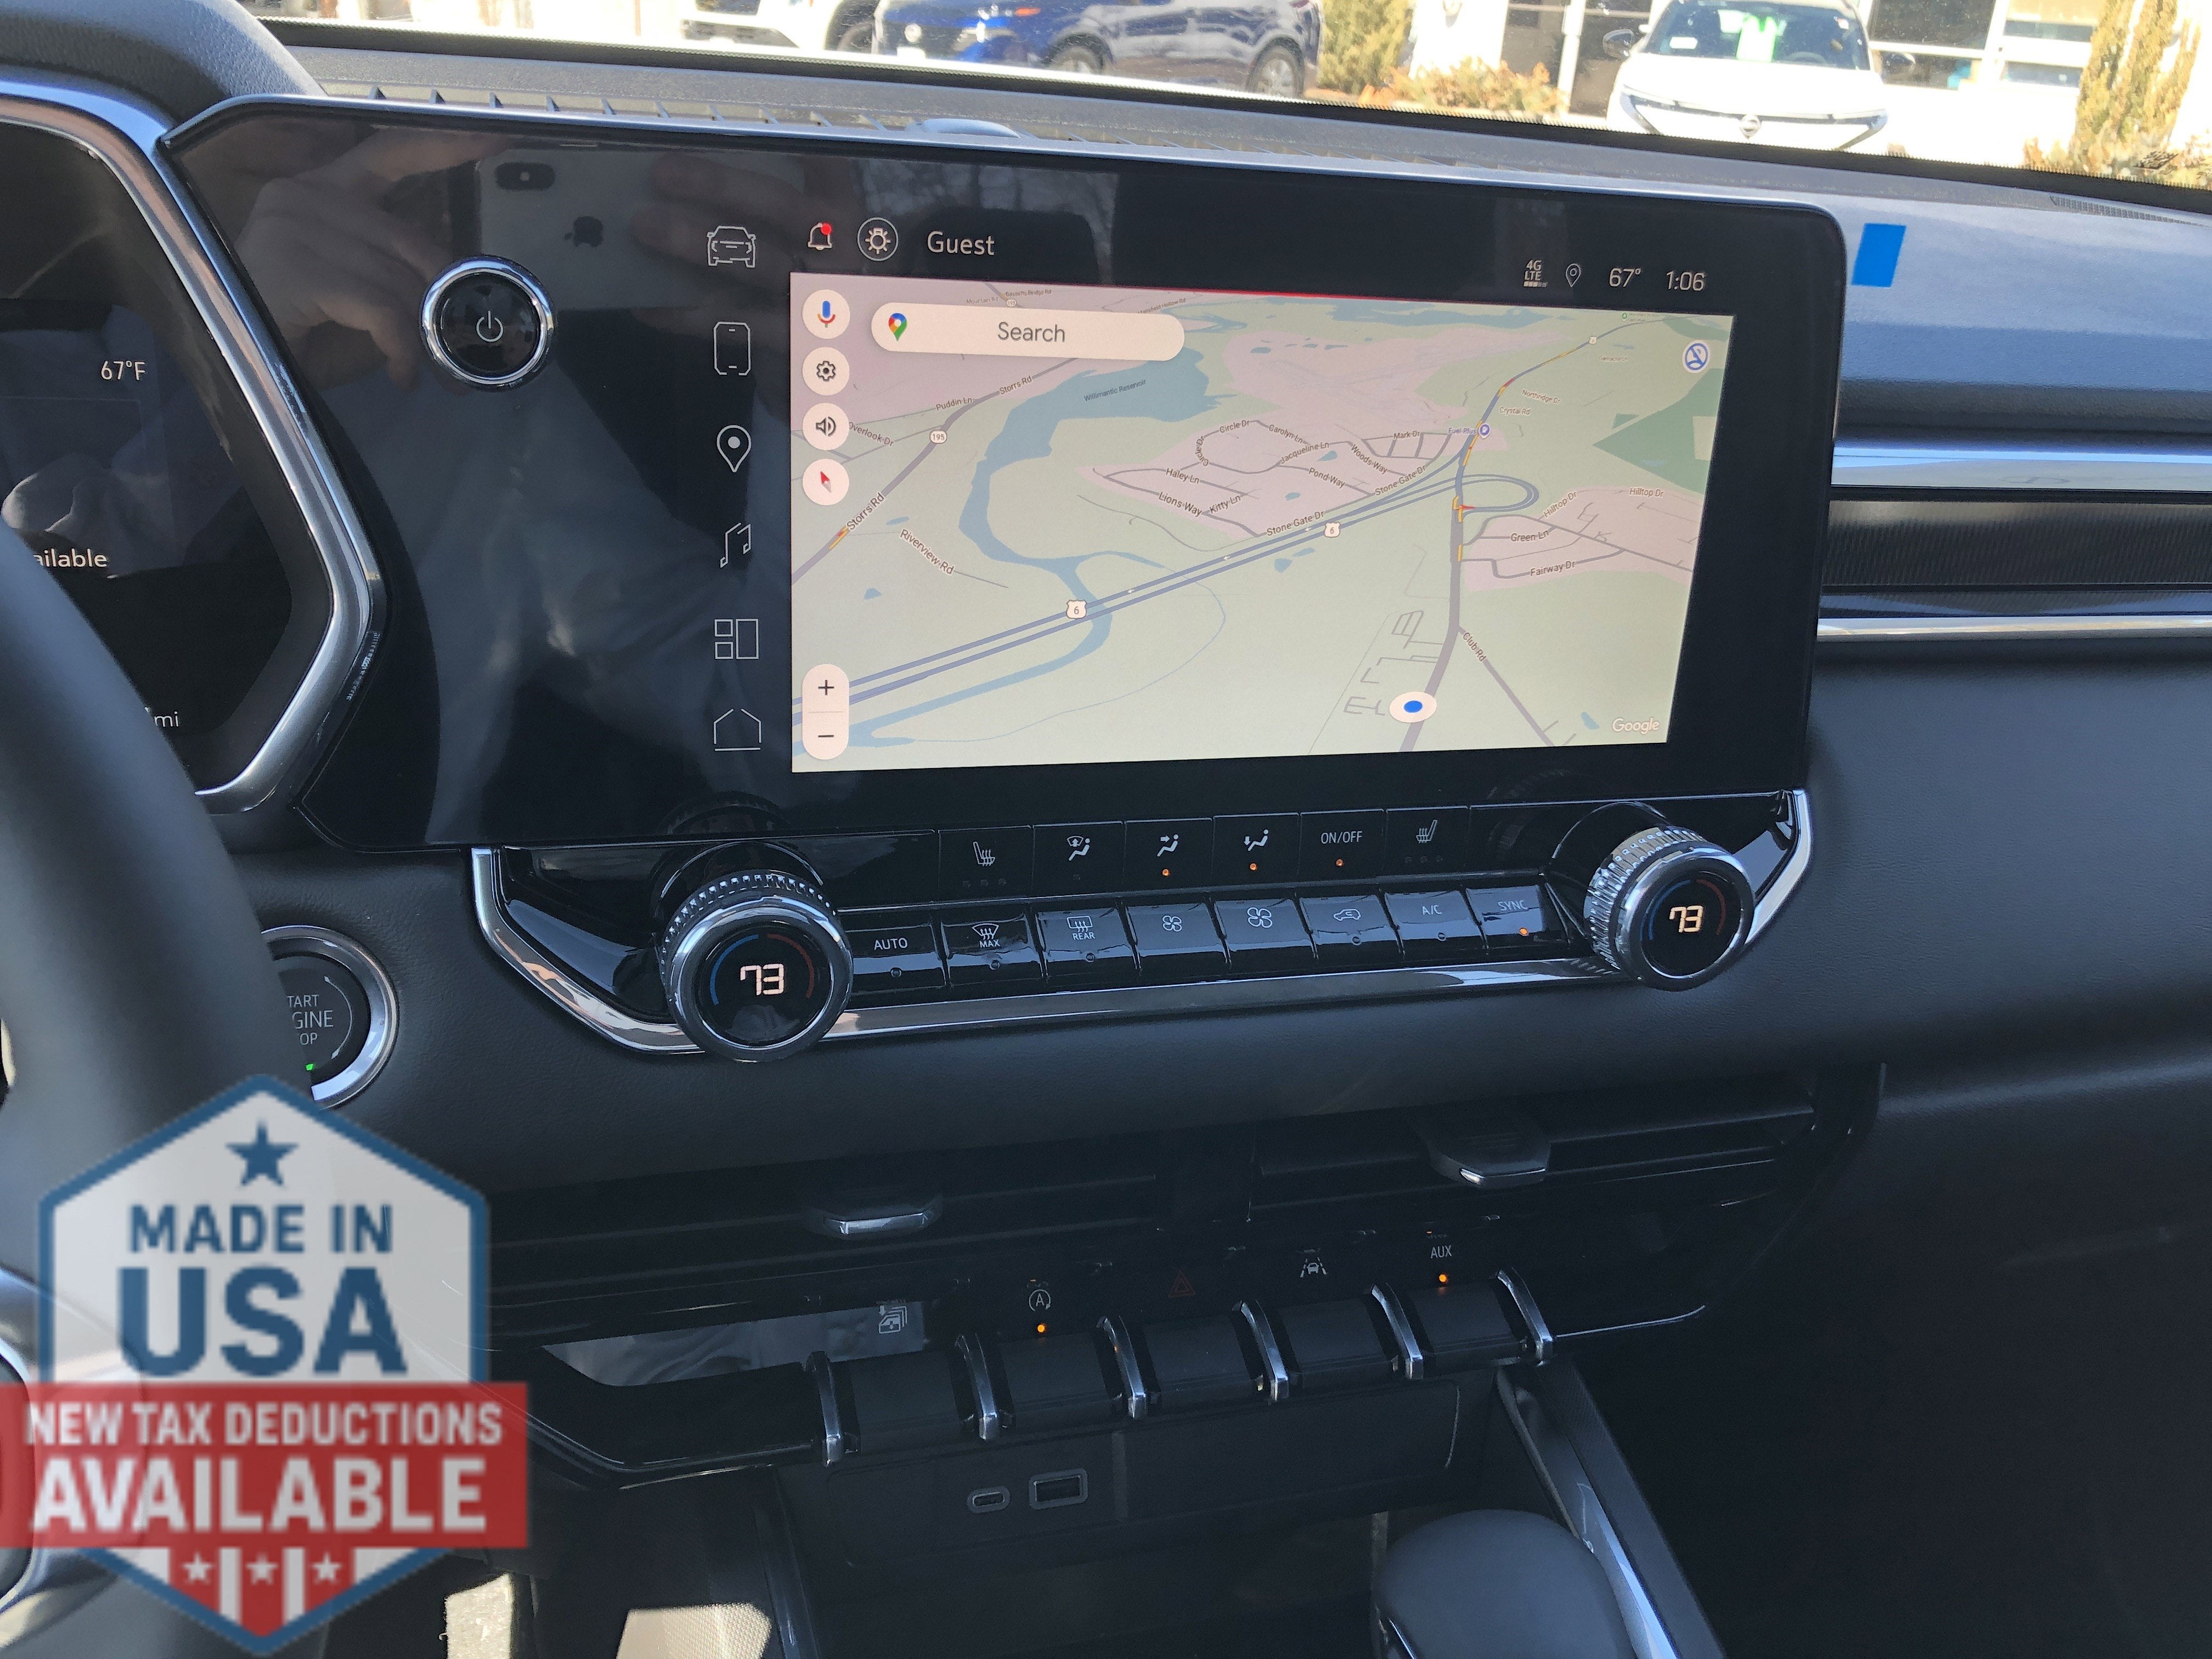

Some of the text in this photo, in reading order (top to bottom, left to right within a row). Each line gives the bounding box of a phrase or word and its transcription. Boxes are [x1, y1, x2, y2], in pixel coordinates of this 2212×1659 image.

[927, 230, 995, 256] Guest
[1525, 259, 1542, 271] 4G
[1524, 271, 1542, 281] LTE
[1609, 267, 1642, 287] 67°
[1666, 270, 1706, 291] 1:06
[997, 321, 1066, 343] Search
[999, 375, 1032, 396] Storrs Rd
[1084, 379, 1147, 402] Willimantic Reservoir
[935, 396, 973, 411] Puddin Ln
[1521, 389, 1551, 403] Northridge
[1499, 407, 1520, 416] Crystal
[849, 421, 894, 447] Overlook Dr
[1219, 422, 1240, 433] Circle
[1268, 424, 1304, 444] Carolyn Ln
[1393, 431, 1411, 439] Mark
[1195, 435, 1209, 466] Circle Dr
[1280, 443, 1319, 464] Jacqueline
[1351, 444, 1388, 475] Woods Way
[1165, 467, 1200, 484] Haley Ln
[1308, 467, 1346, 488] Pond Way
[1375, 466, 1426, 496] Stone Gate Dr
[1629, 487, 1664, 498] Hilltop Dr
[846, 492, 885, 531] Storrs Rd
[1158, 491, 1203, 518] Lions Way
[1209, 495, 1241, 515] Kitty Ln
[1543, 490, 1577, 518] Hilltop Dr
[1266, 510, 1325, 537] Stone Gate Dr
[1510, 529, 1549, 542] Green Ln
[900, 528, 955, 575] Riverview Rd
[1530, 560, 1576, 578] Fairway Dr
[1073, 605, 1080, 616] 6
[1462, 632, 1487, 663] Club Rd
[154, 711, 179, 727] mi
[1611, 717, 1660, 734] Google
[1320, 830, 1363, 844] ON/OFF
[1421, 904, 1442, 916] A/C
[1497, 900, 1529, 912] SYNC
[1668, 905, 1703, 933] 73
[874, 938, 909, 951] AUTO
[979, 939, 1001, 948] MAX
[1073, 932, 1096, 941] REAR
[740, 963, 785, 995] 73
[286, 994, 319, 1008] TART
[292, 1010, 334, 1029] GINE
[300, 1032, 318, 1046] OP
[1430, 1245, 1452, 1259] AUX
